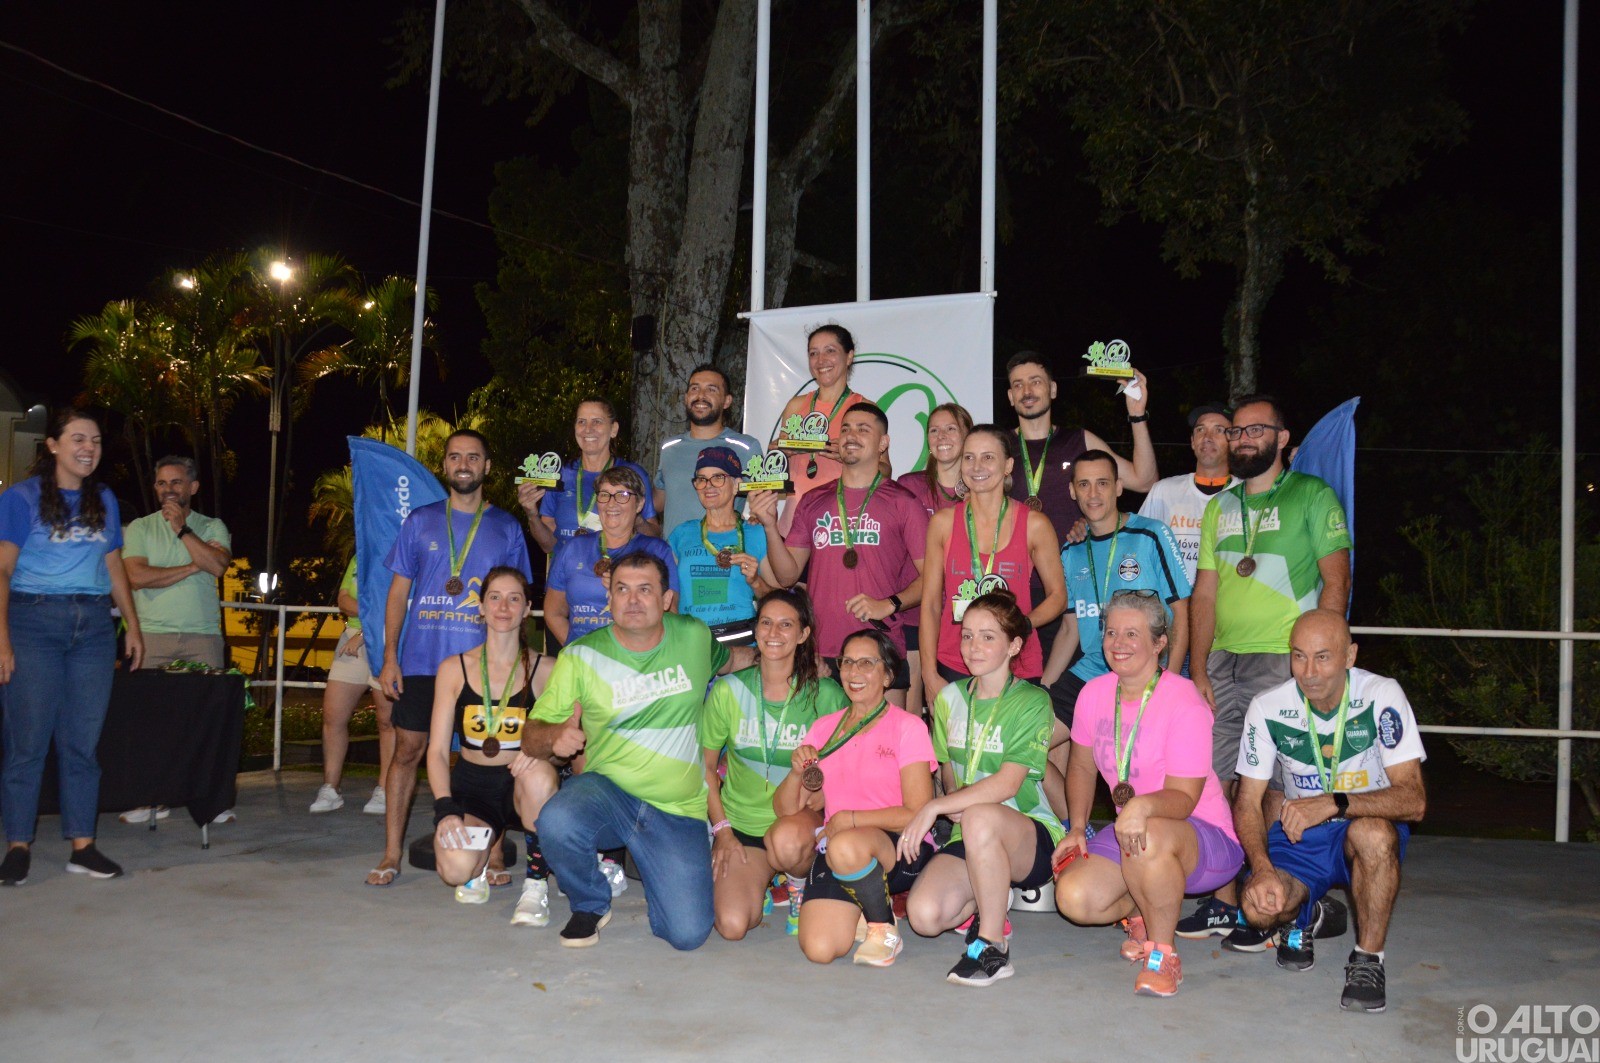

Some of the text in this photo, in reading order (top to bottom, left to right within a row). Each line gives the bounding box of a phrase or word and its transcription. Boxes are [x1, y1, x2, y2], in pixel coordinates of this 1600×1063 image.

[419, 596, 454, 606] ATLETA
[613, 664, 690, 698] RÚSTICA
[650, 683, 688, 699] PLANALTO
[1279, 710, 1299, 718] MTX
[471, 714, 520, 734] 39
[1207, 914, 1230, 927] FILA
